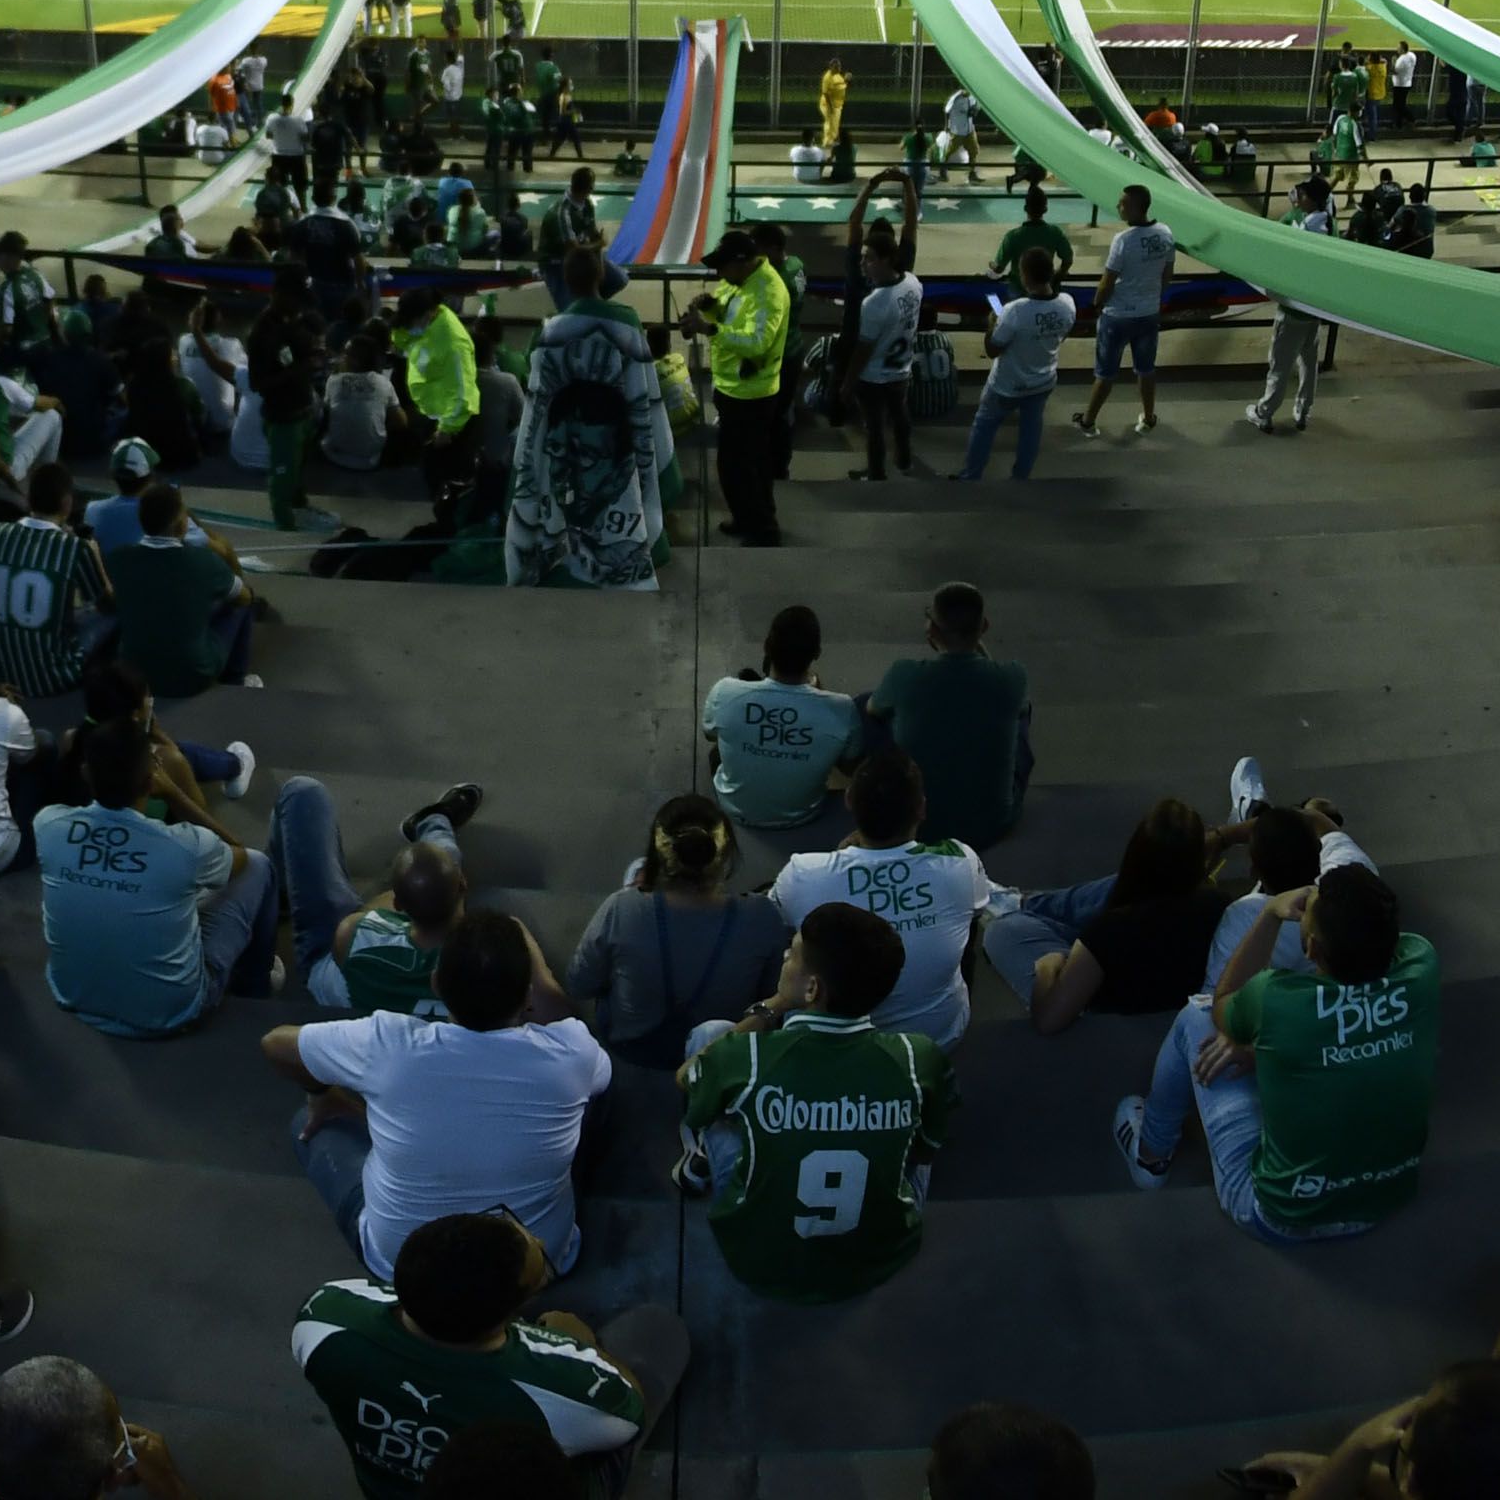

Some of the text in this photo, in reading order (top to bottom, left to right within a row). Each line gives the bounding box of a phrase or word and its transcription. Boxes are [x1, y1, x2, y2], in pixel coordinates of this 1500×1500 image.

[746, 703, 798, 725] DEO
[743, 741, 811, 761] Recamier
[67, 820, 129, 847] DEO
[59, 866, 141, 894] Recamier
[848, 862, 910, 896] DEO
[1321, 1031, 1414, 1067] Recamier
[755, 1084, 915, 1135] Colombiana
[793, 1148, 871, 1240] 9
[357, 1400, 450, 1448] DEO
